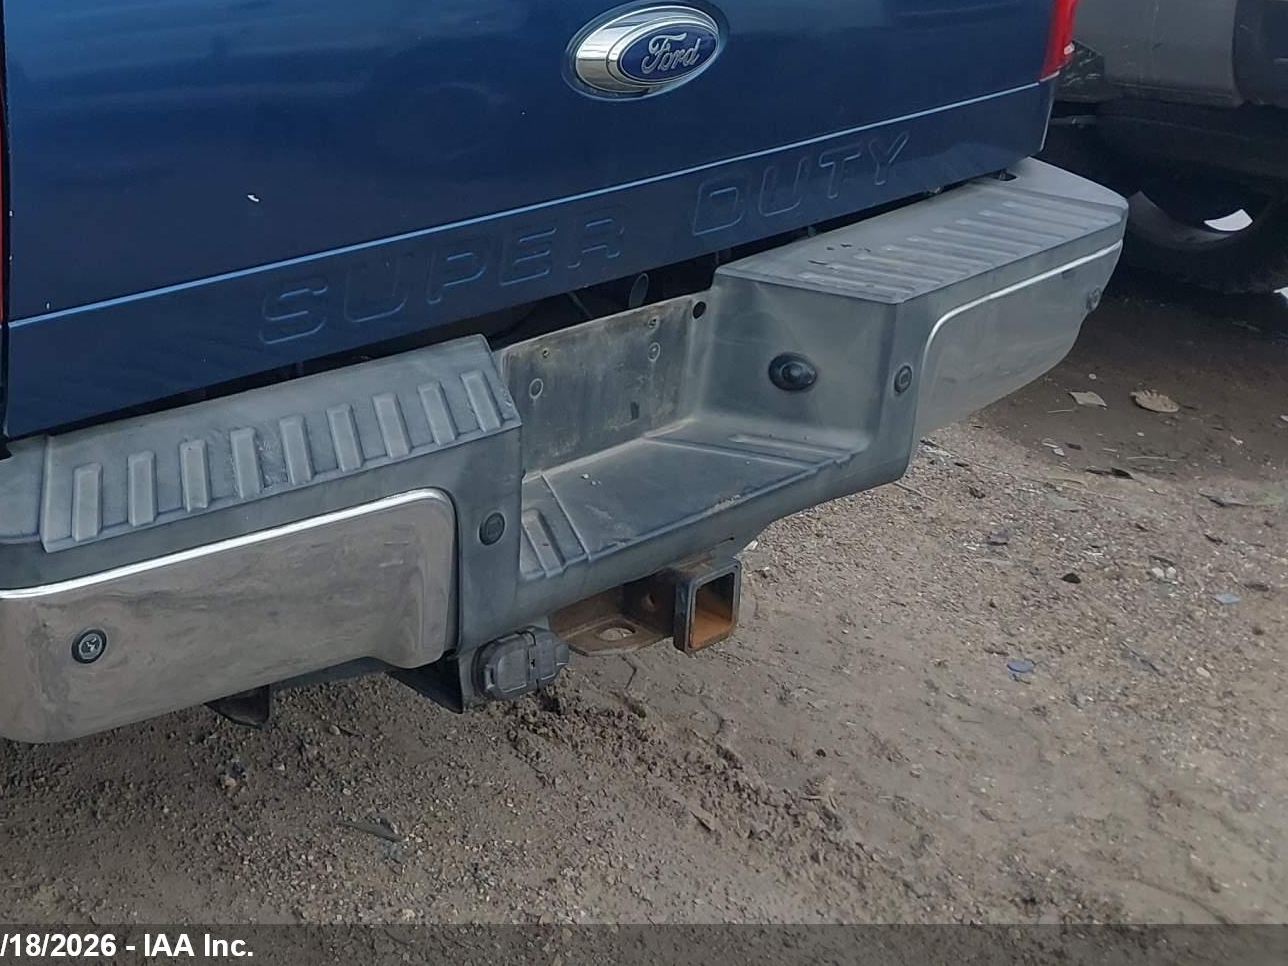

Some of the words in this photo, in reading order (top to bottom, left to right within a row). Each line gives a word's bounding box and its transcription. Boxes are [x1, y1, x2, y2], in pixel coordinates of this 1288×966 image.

[641, 32, 701, 74] Ford
[260, 213, 624, 345] SUPER
[692, 134, 910, 236] DUTY
